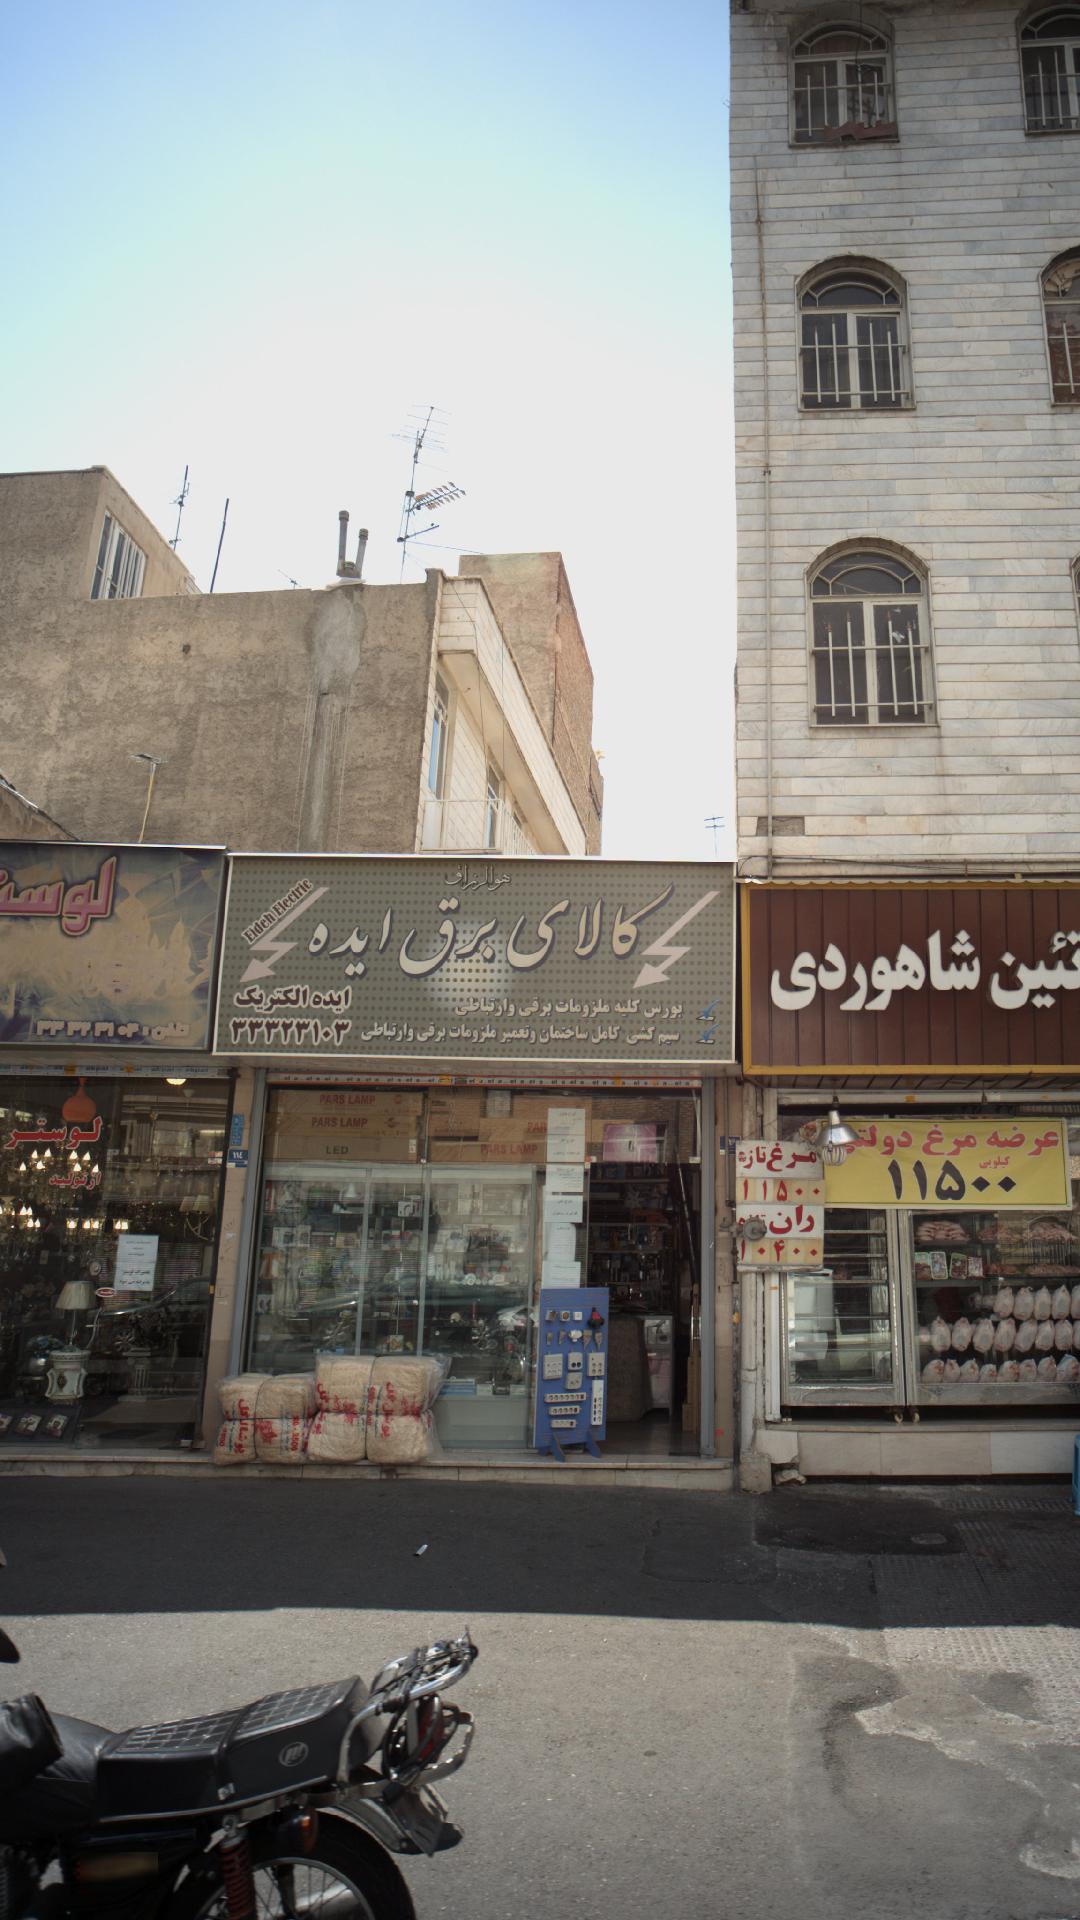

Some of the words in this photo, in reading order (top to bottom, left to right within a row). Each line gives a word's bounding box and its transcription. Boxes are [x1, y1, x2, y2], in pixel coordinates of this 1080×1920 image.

[241, 910, 278, 945] Eideh
[272, 878, 314, 917] Electric
[399, 896, 498, 976] برق
[505, 880, 675, 970] کالای
[308, 905, 392, 977] ایده
[771, 929, 981, 1011] شاهوردی
[234, 985, 310, 1013] الکتریک
[311, 985, 352, 1013] ایده
[519, 996, 552, 1017] برقی
[555, 999, 611, 1018] ملزومات
[614, 998, 641, 1017] کلیه
[643, 1003, 684, 1018] بورس
[229, 1017, 352, 1046] ۳۳۳۲۳۱۰۳
[416, 1021, 446, 1042] برقی
[450, 1023, 497, 1044] ملزومات
[539, 1024, 588, 1043] ساختمان
[591, 1024, 621, 1044] کامل
[626, 1025, 656, 1045] کشی
[658, 1030, 681, 1046] سیم
[349, 1094, 376, 1105] LAMP
[4, 1115, 103, 1149] لوستر
[311, 1116, 338, 1128] PARS
[340, 1117, 368, 1128] LAMP
[326, 1145, 349, 1155] LED
[922, 1124, 977, 1156] مرغ
[985, 1126, 1060, 1156] عرضه
[737, 1146, 767, 1169] تازه
[766, 1142, 817, 1172] مرغ
[743, 1179, 821, 1201] ۱۱۵۰۰
[887, 1159, 1017, 1201] ۱۱۵۰۰
[768, 1204, 815, 1235] ران
[740, 1239, 818, 1263] ۱۰۴۰۰
